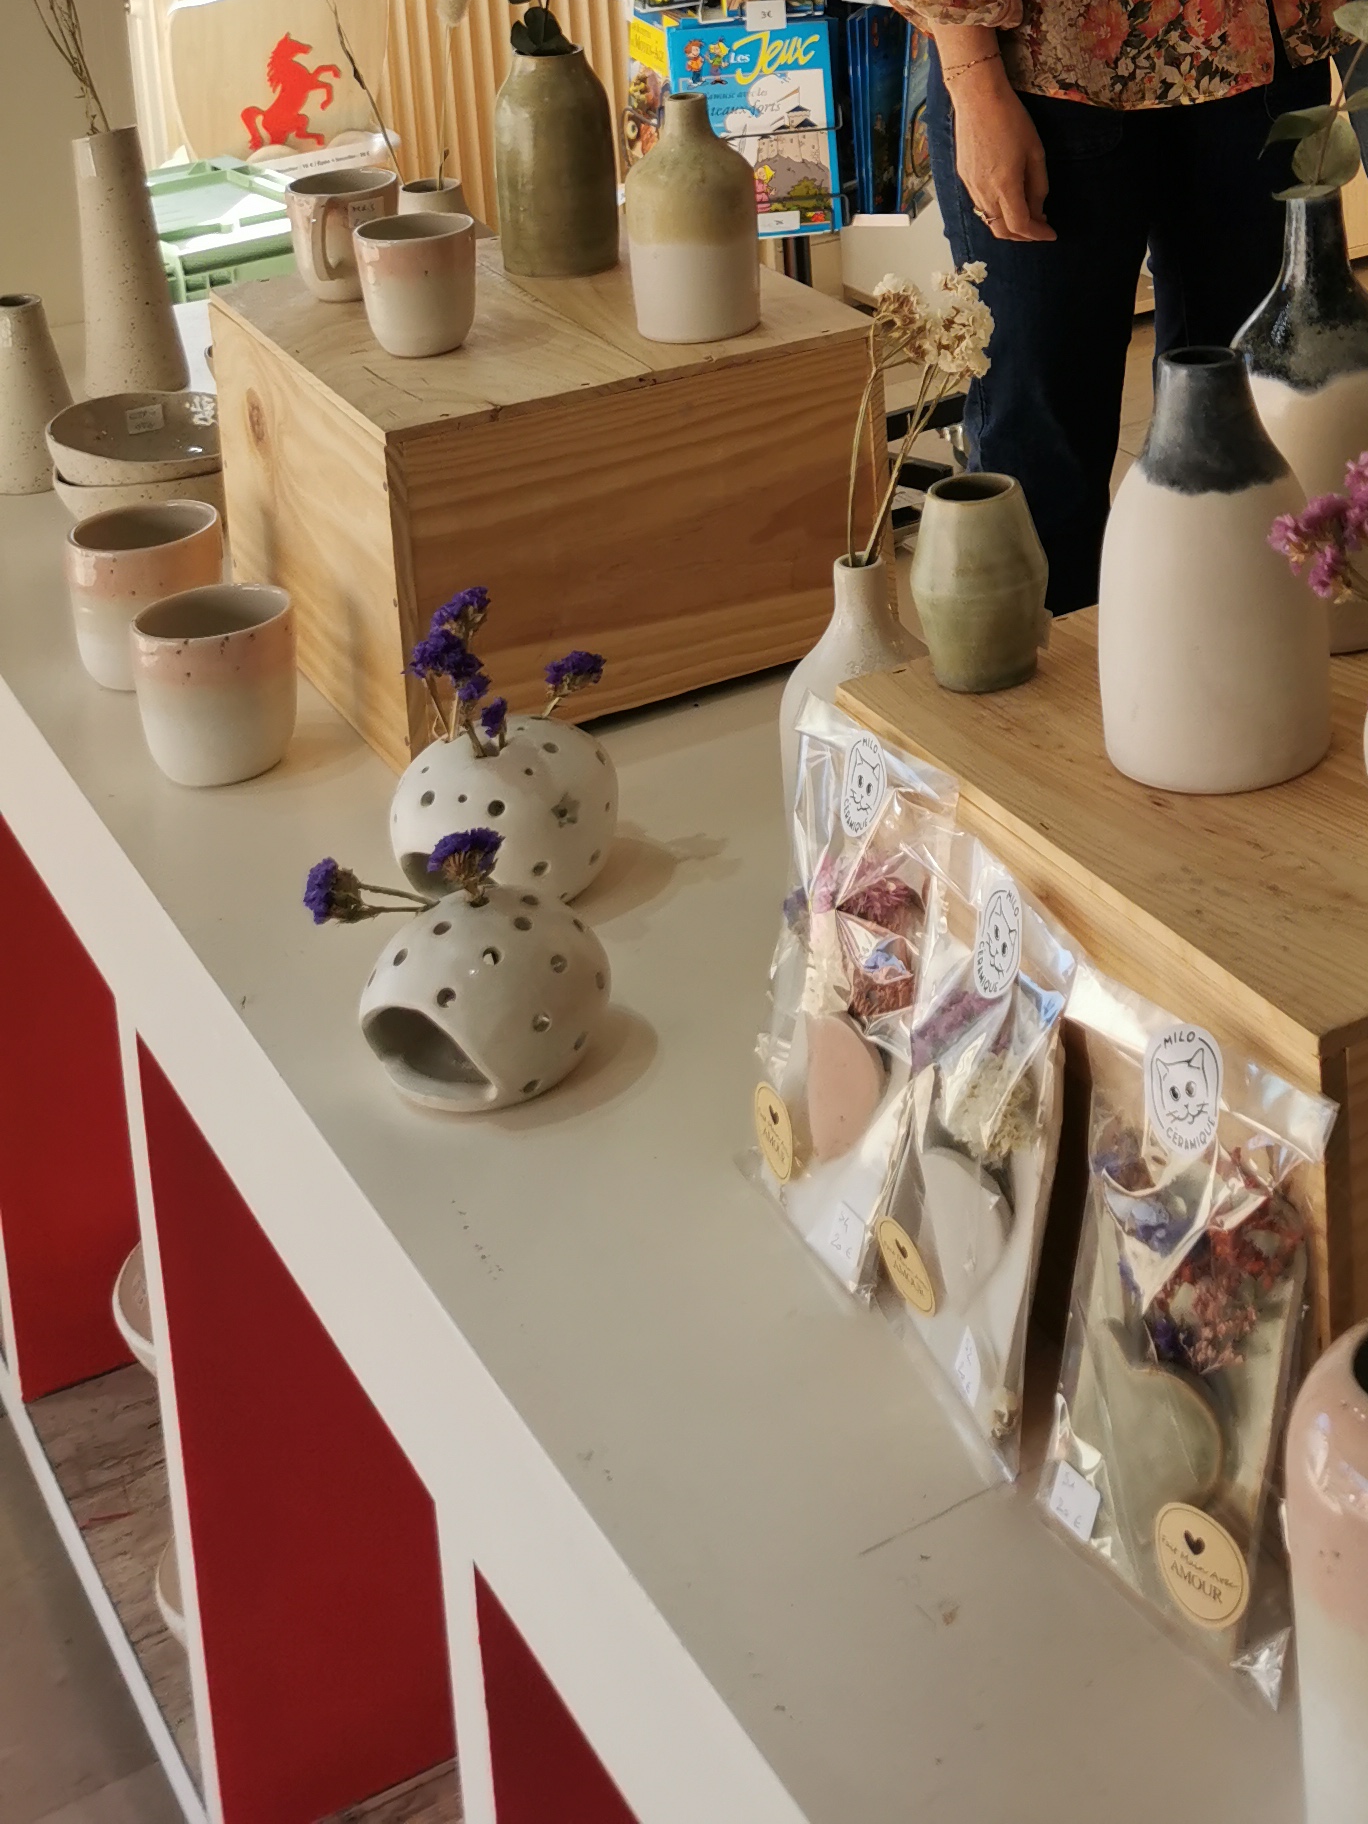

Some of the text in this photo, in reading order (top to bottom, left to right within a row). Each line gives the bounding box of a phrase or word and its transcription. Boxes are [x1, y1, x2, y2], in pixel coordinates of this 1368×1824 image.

[760, 10, 774, 19] 3€
[729, 30, 821, 86] Les Jeux
[862, 737, 878, 754] MILO
[1005, 889, 1020, 918] MILO
[1163, 1030, 1197, 1050] MILO
[1166, 1115, 1216, 1151] CÉRAMIQUE
[1169, 1560, 1224, 1605] AMOUR
